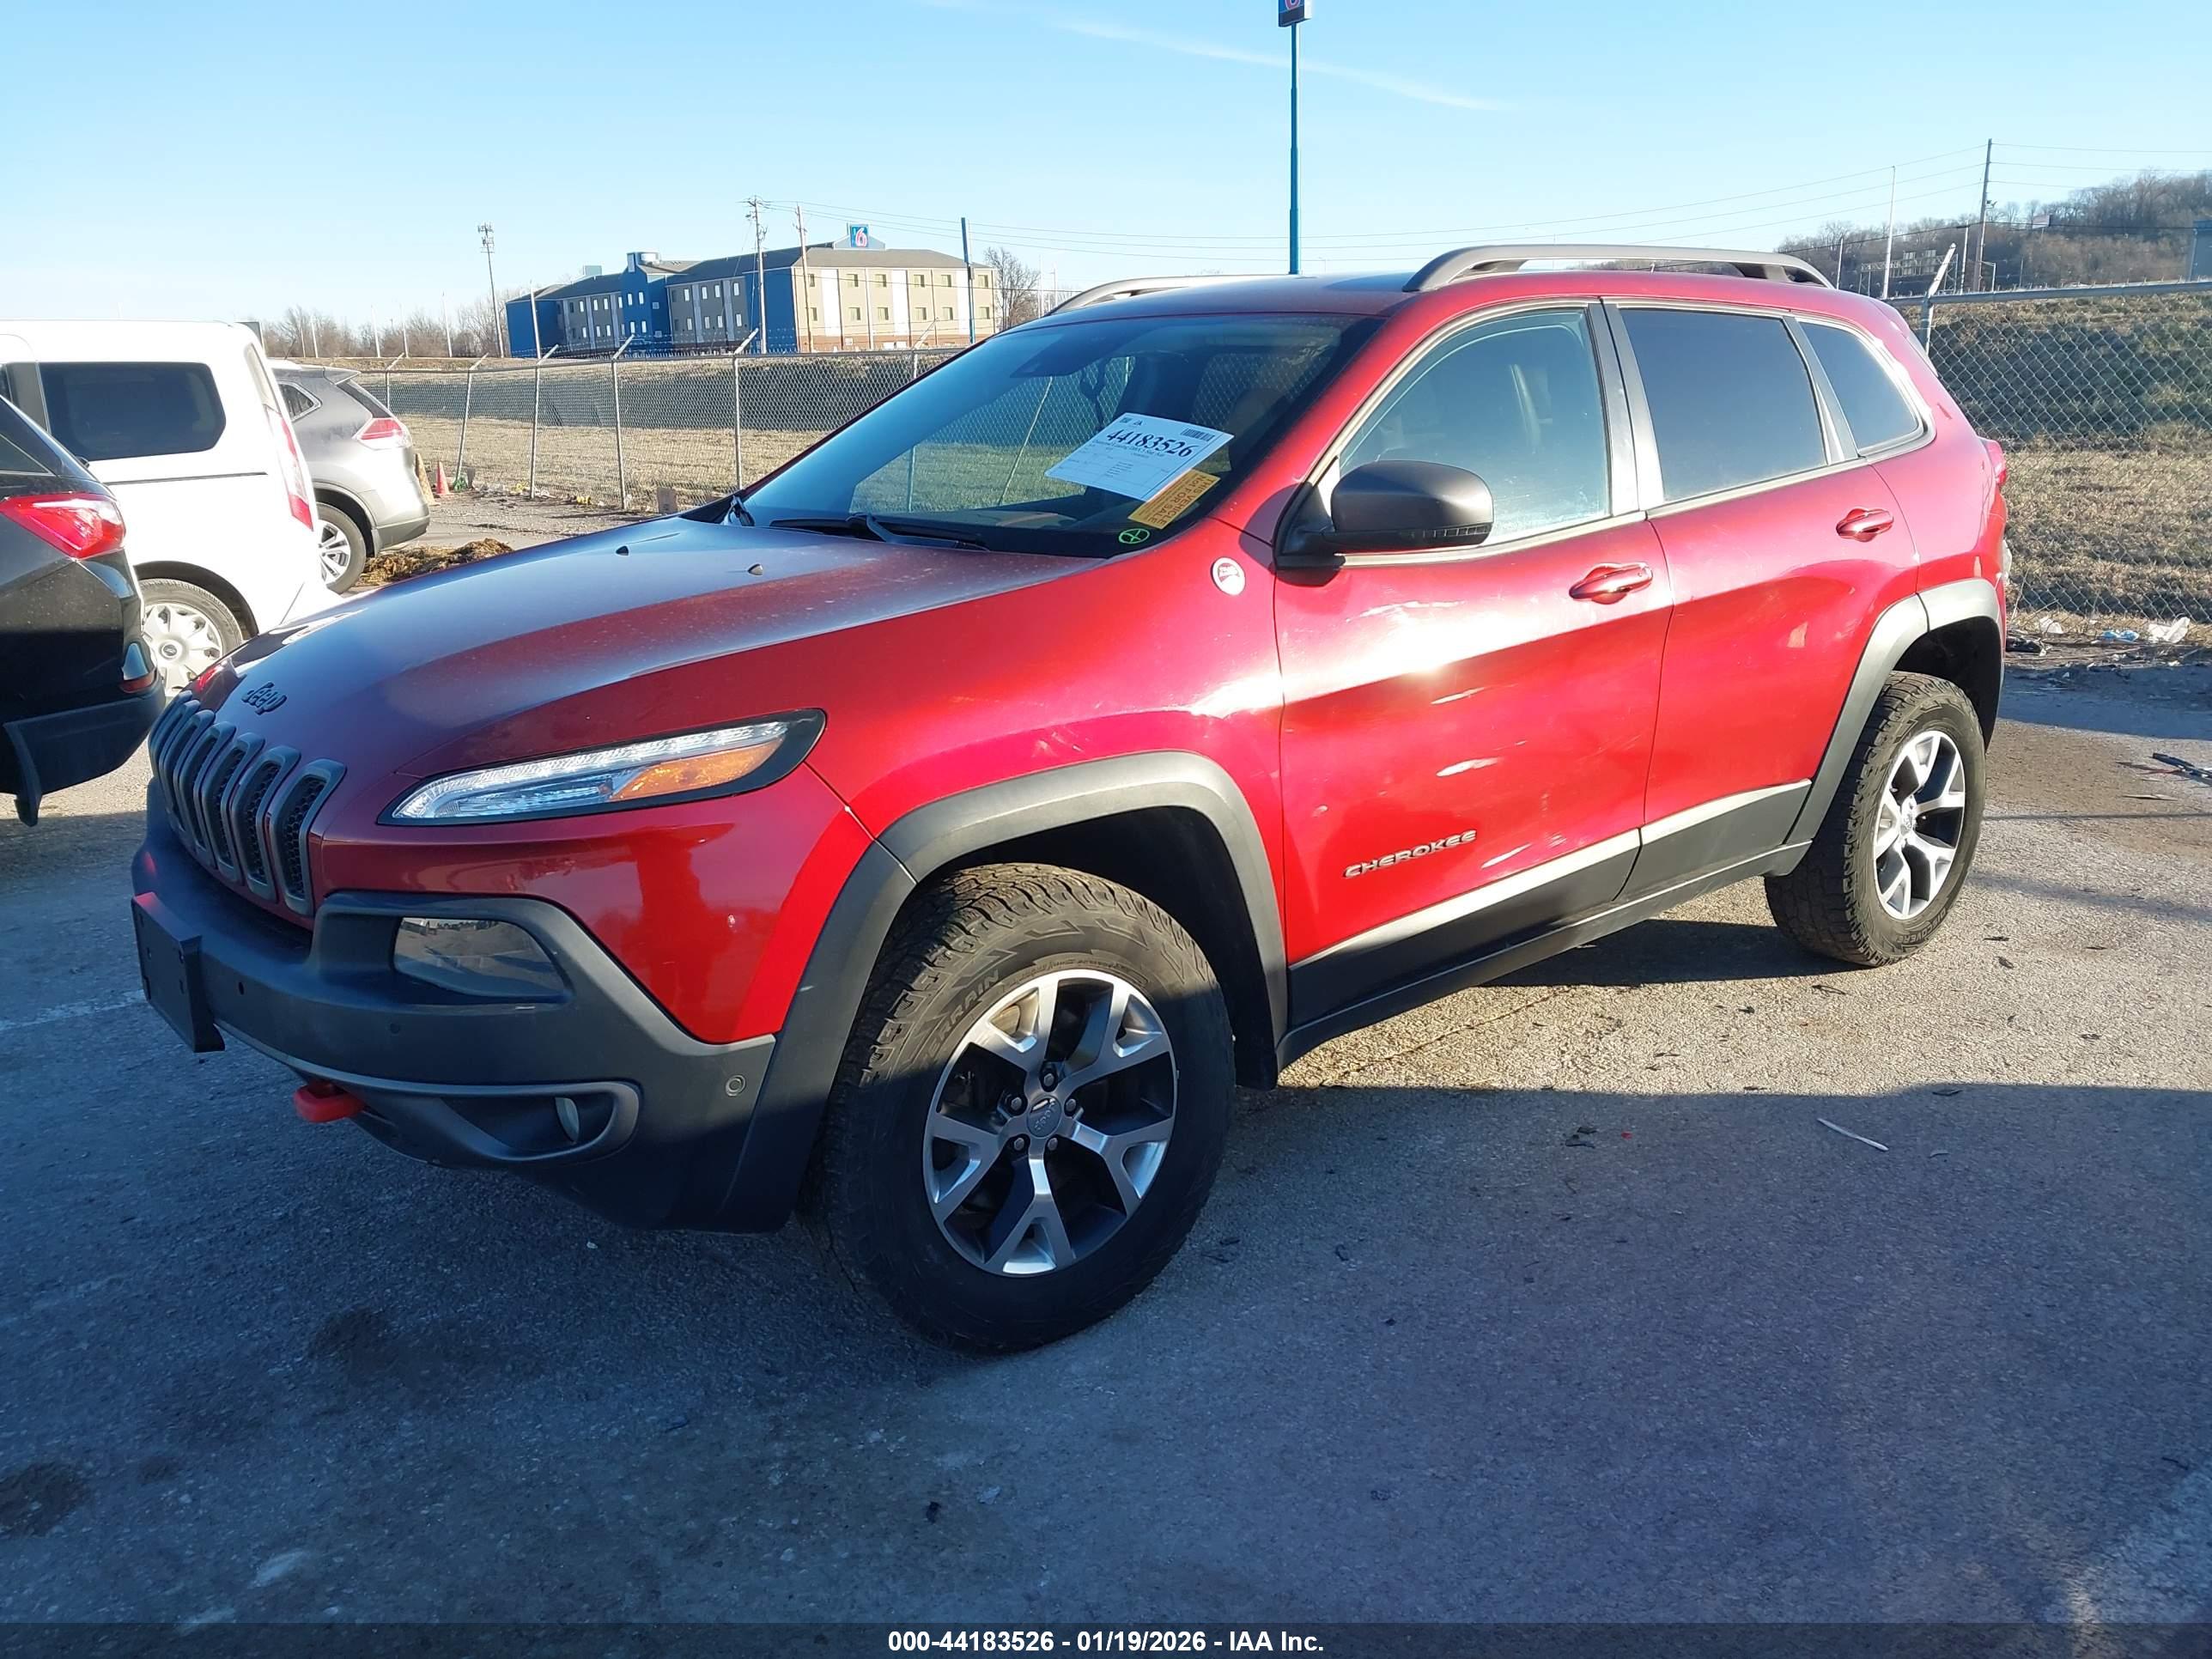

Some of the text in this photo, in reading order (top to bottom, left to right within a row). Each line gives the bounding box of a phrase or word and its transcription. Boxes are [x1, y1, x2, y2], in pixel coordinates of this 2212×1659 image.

[855, 227, 867, 247] 6
[1107, 428, 1200, 458] 44183526
[1157, 495, 1194, 526] VEHICLE
[1170, 487, 1193, 504] FOR
[241, 681, 288, 715] Jeep
[1343, 829, 1477, 879] CHEROKEE
